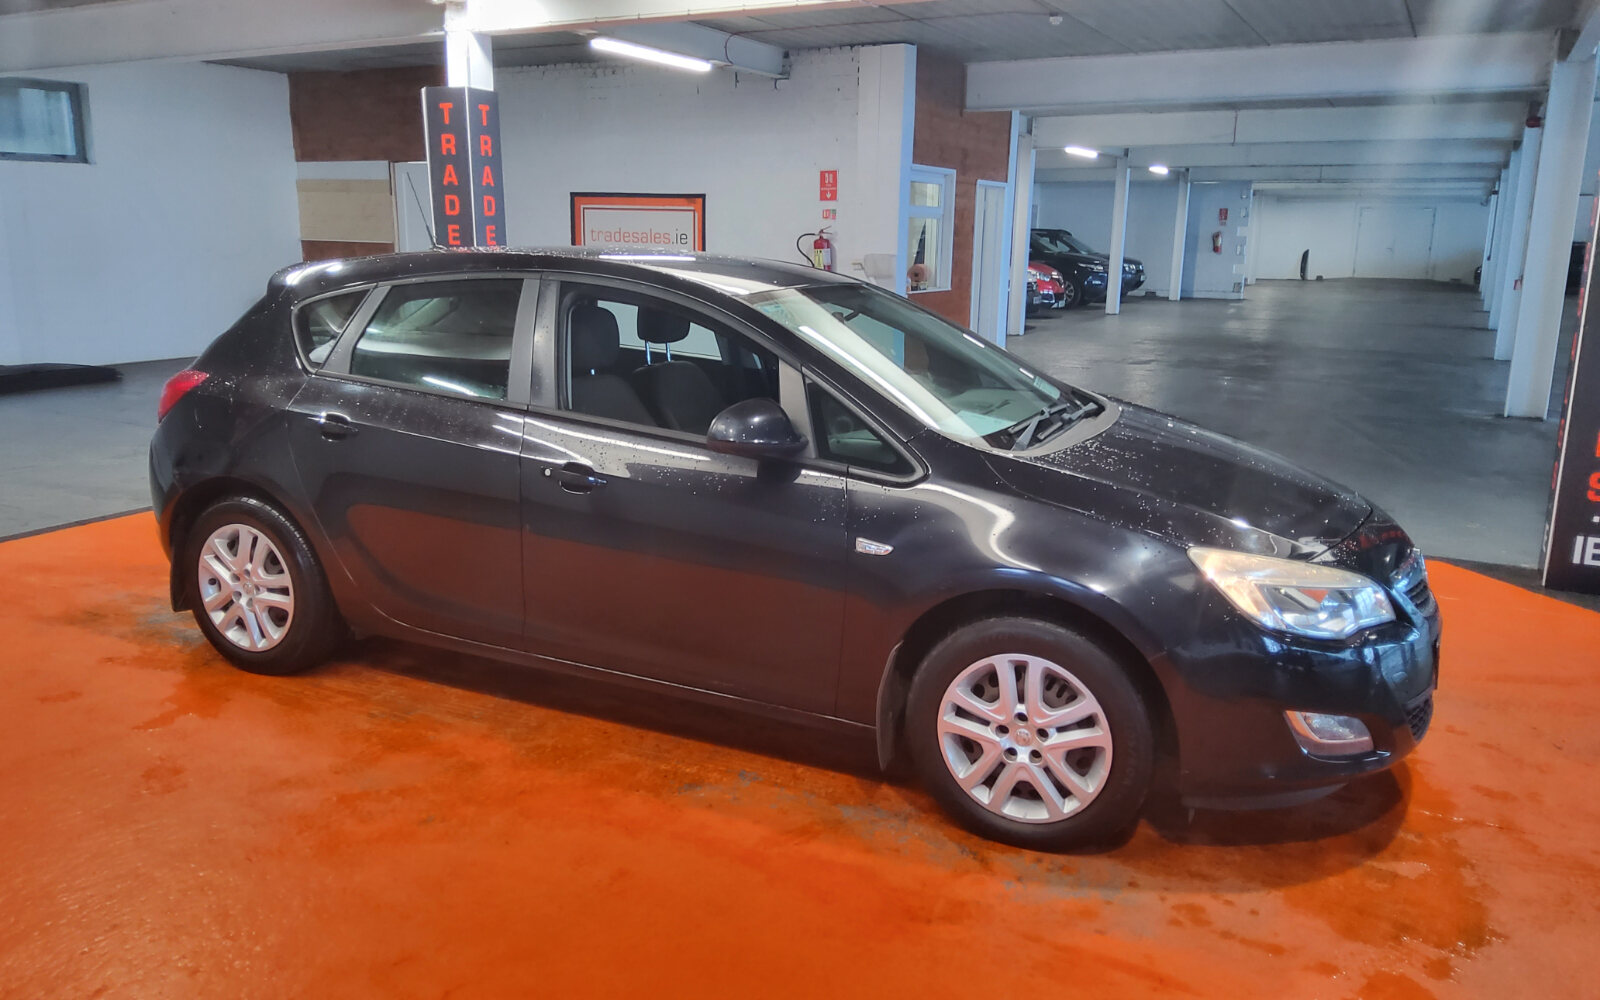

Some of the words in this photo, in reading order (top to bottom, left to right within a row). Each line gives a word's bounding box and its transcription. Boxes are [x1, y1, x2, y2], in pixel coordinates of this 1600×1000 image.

[439, 102, 461, 246] TRADE
[478, 104, 497, 246] TRADE
[590, 227, 688, 245] tradesales.ie
